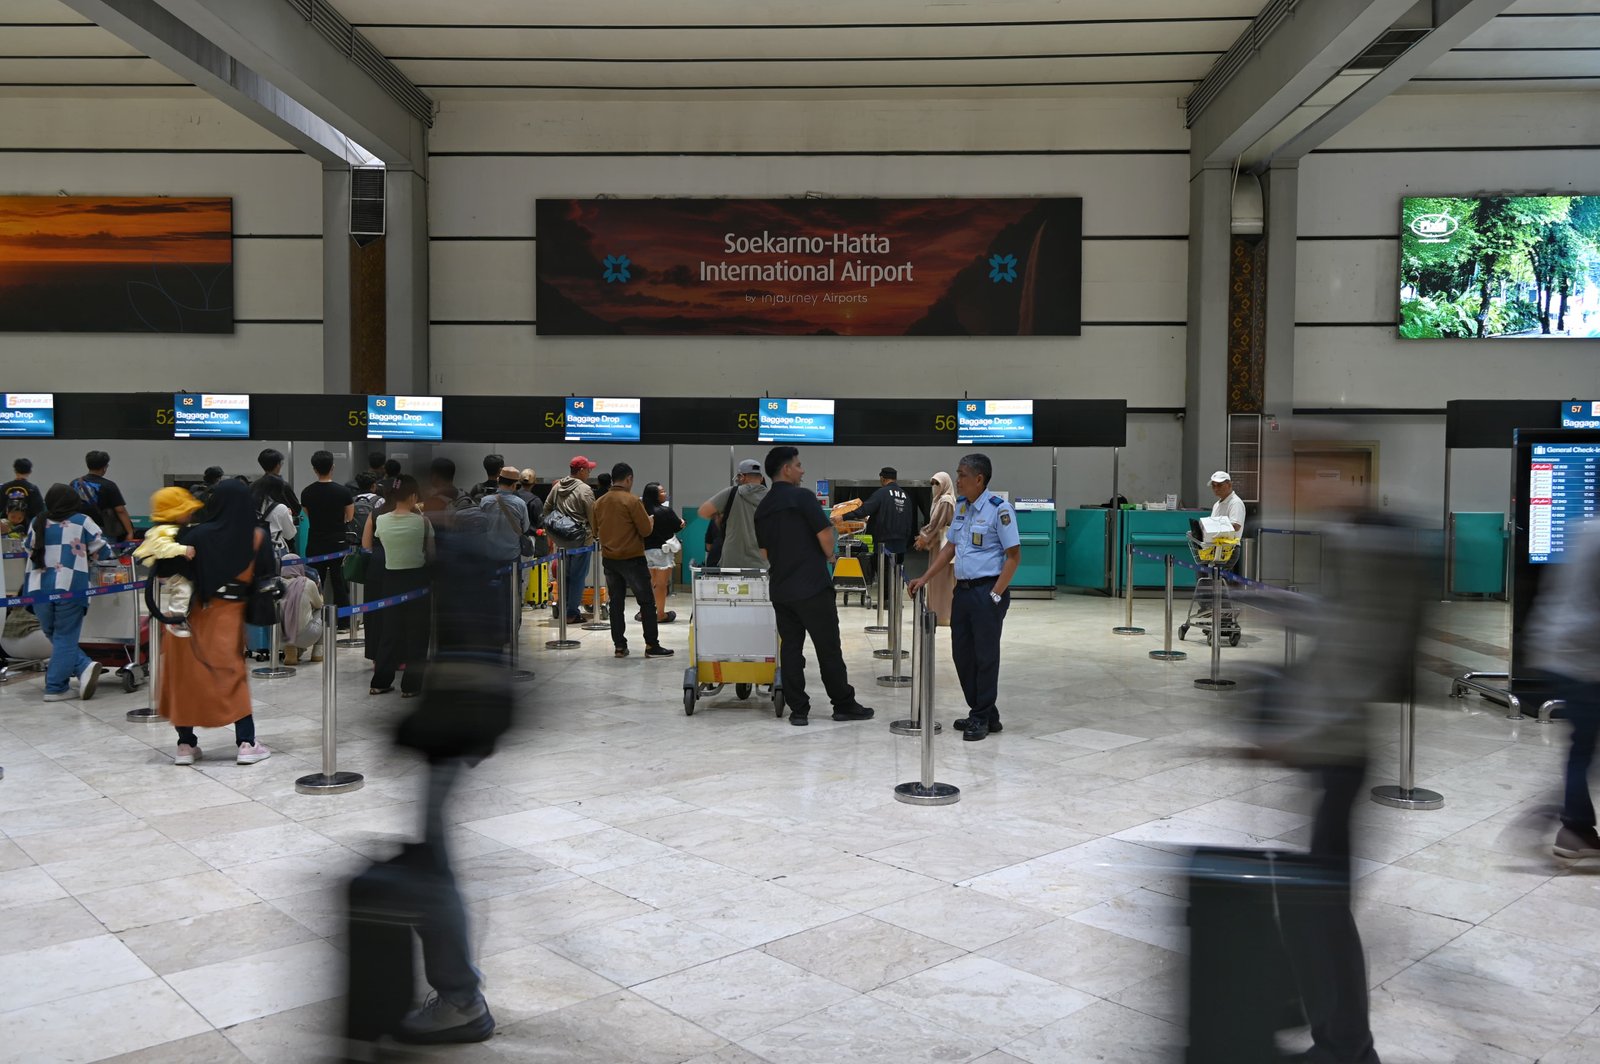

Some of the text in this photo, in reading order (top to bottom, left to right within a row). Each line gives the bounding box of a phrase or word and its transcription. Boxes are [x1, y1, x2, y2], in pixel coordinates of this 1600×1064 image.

[724, 230, 890, 254] Soekarno-Hatta
[700, 258, 914, 287] International Airport
[745, 294, 756, 303] by
[822, 292, 868, 304] Airports
[183, 397, 193, 406] 52
[376, 399, 387, 407] 53
[574, 401, 584, 409] 54
[768, 402, 778, 410] 55
[966, 404, 977, 412] 56
[1571, 405, 1582, 413] 57
[15, 411, 34, 420] Drop
[156, 409, 174, 425] 52
[176, 411, 229, 420] Baggage Drop
[369, 412, 422, 422] Baggage Drop
[544, 412, 565, 428] 54
[567, 415, 620, 424] Baggage Drop
[760, 415, 814, 424] Baggage Drop
[737, 413, 758, 429] 55
[935, 415, 956, 431] 56
[959, 417, 1013, 427] Baggage Drop
[1563, 419, 1600, 428] Baggage
